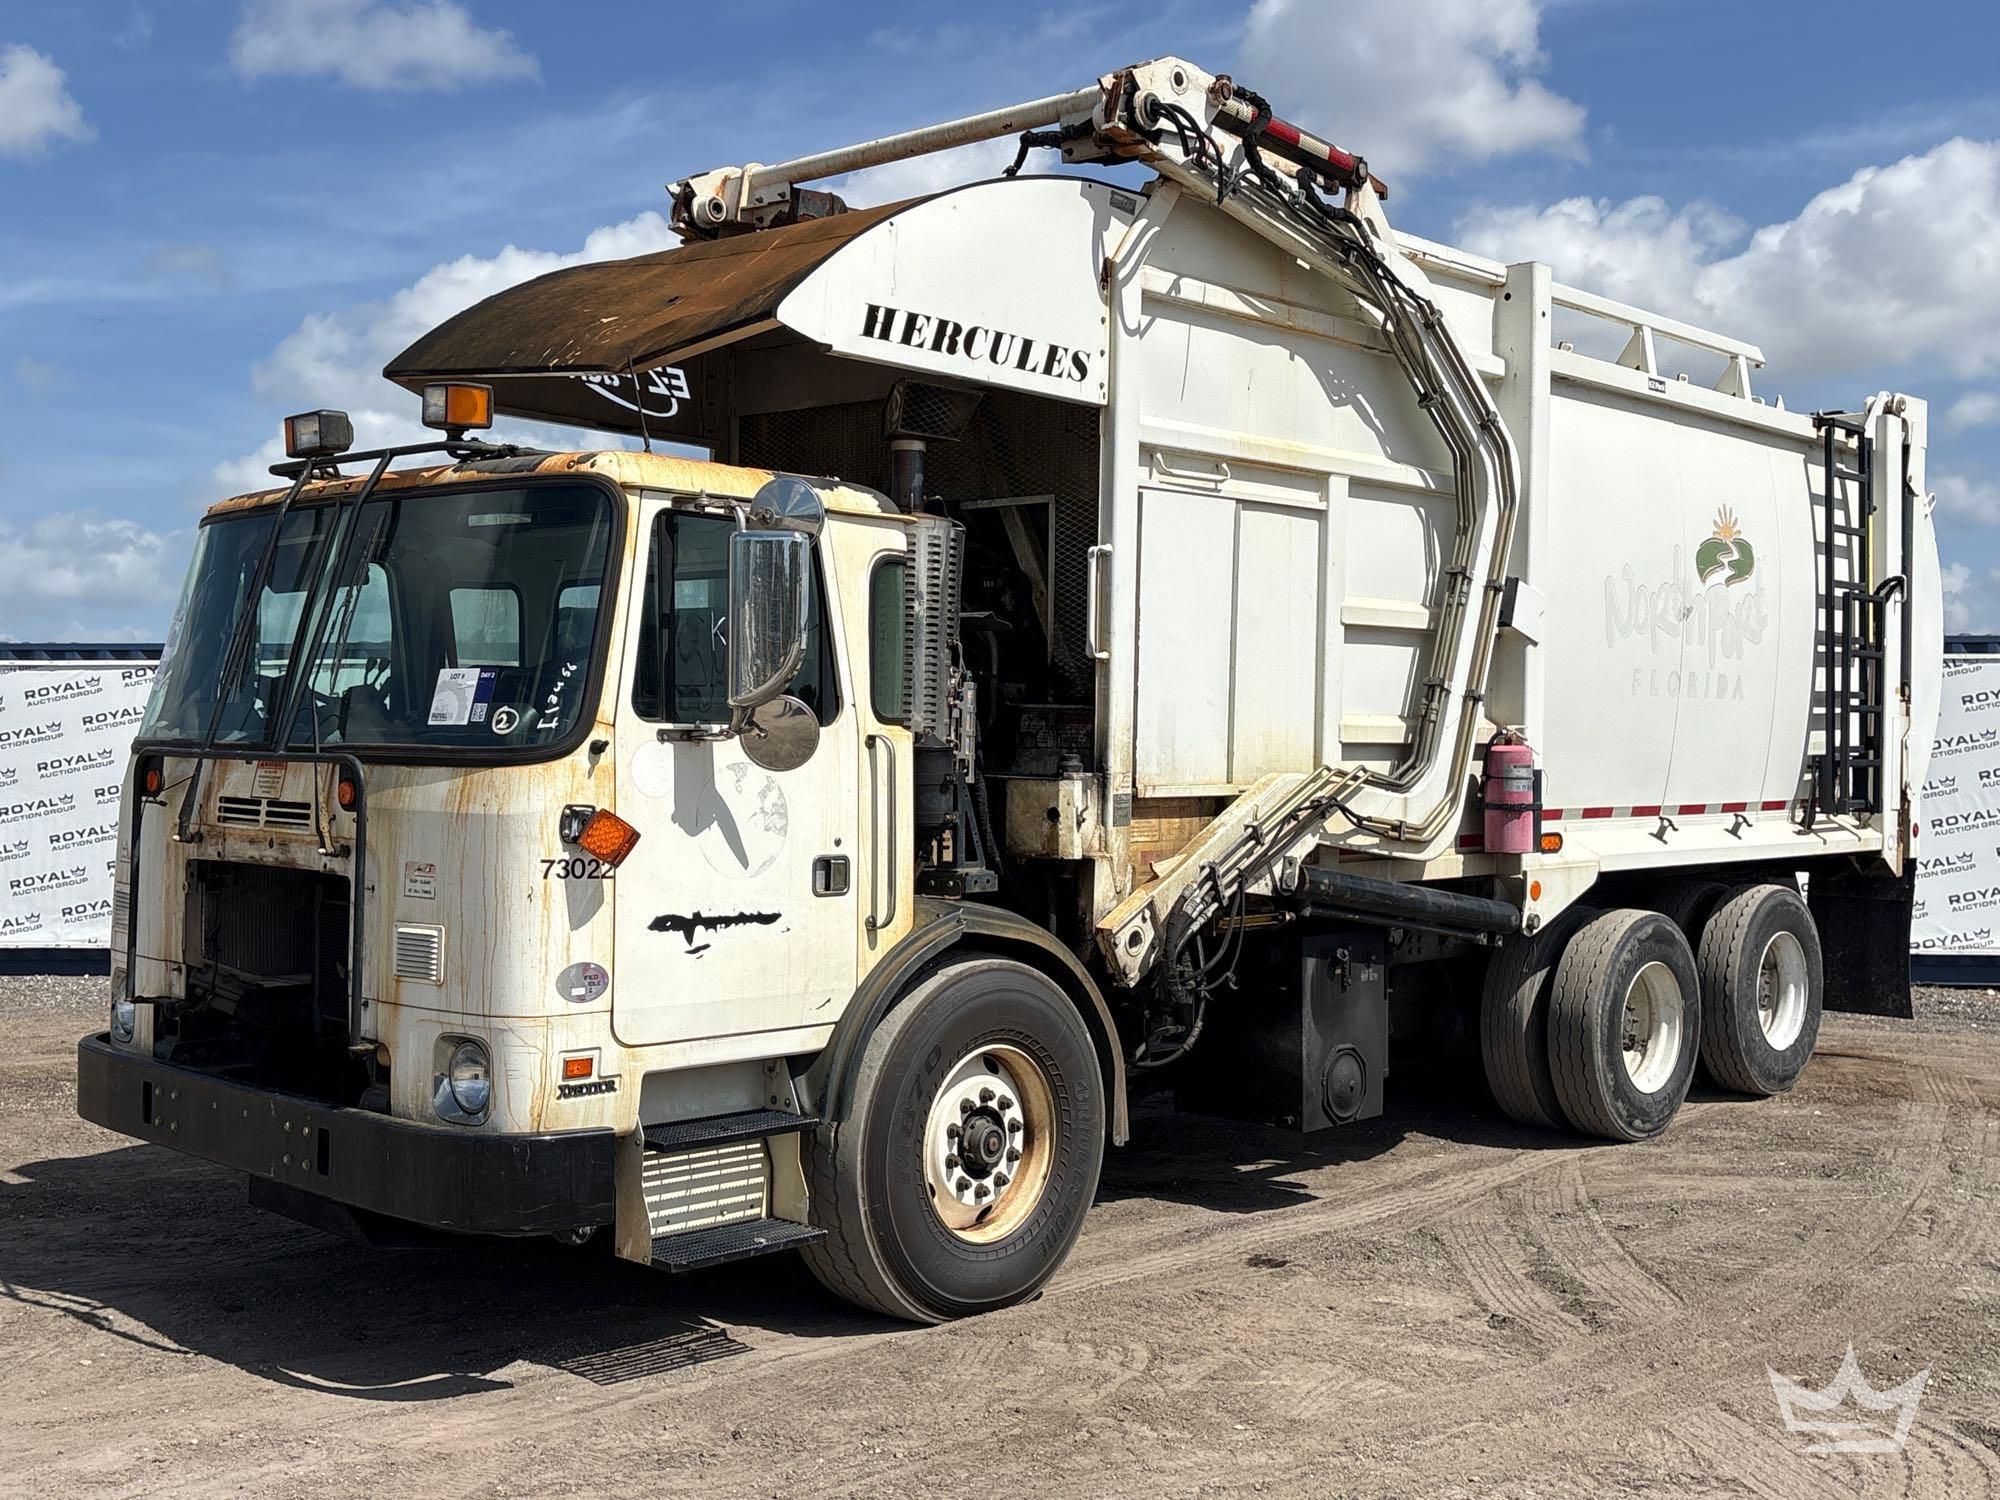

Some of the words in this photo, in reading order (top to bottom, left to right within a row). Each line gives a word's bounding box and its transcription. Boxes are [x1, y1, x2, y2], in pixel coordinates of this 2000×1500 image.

[859, 303, 1091, 383] HERCULES
[1946, 665, 1983, 678] GROUP
[25, 680, 85, 700] ROYAL
[1631, 668, 1744, 700] FLORIDA
[27, 694, 69, 707] AUCTION
[70, 687, 103, 699] GROUP
[82, 706, 143, 726] ROYAL
[84, 720, 126, 733] AUCTION
[31, 732, 64, 744] GROUP
[1963, 741, 2000, 752] GROUP
[37, 752, 98, 772] ROYAL
[39, 766, 81, 779] AUCTION
[82, 759, 115, 771] GROUP
[1923, 787, 1959, 799] GROUP
[0, 798, 59, 816] ROYAL
[0, 810, 42, 824] AUCTION
[43, 805, 76, 816] GROUP
[1931, 809, 1998, 829] ROYAL
[49, 825, 110, 845] ROYAL
[1934, 823, 1980, 837] AUCTION
[51, 839, 93, 852] AUCTION
[540, 858, 614, 880] 73022
[1940, 863, 1976, 875] GROUP
[10, 870, 71, 890] ROYAL
[12, 884, 54, 897] AUCTION
[55, 877, 89, 889] GROUP
[1952, 900, 1997, 913] AUCTION
[64, 911, 105, 925] AUCTION
[9, 923, 43, 935] GROUP
